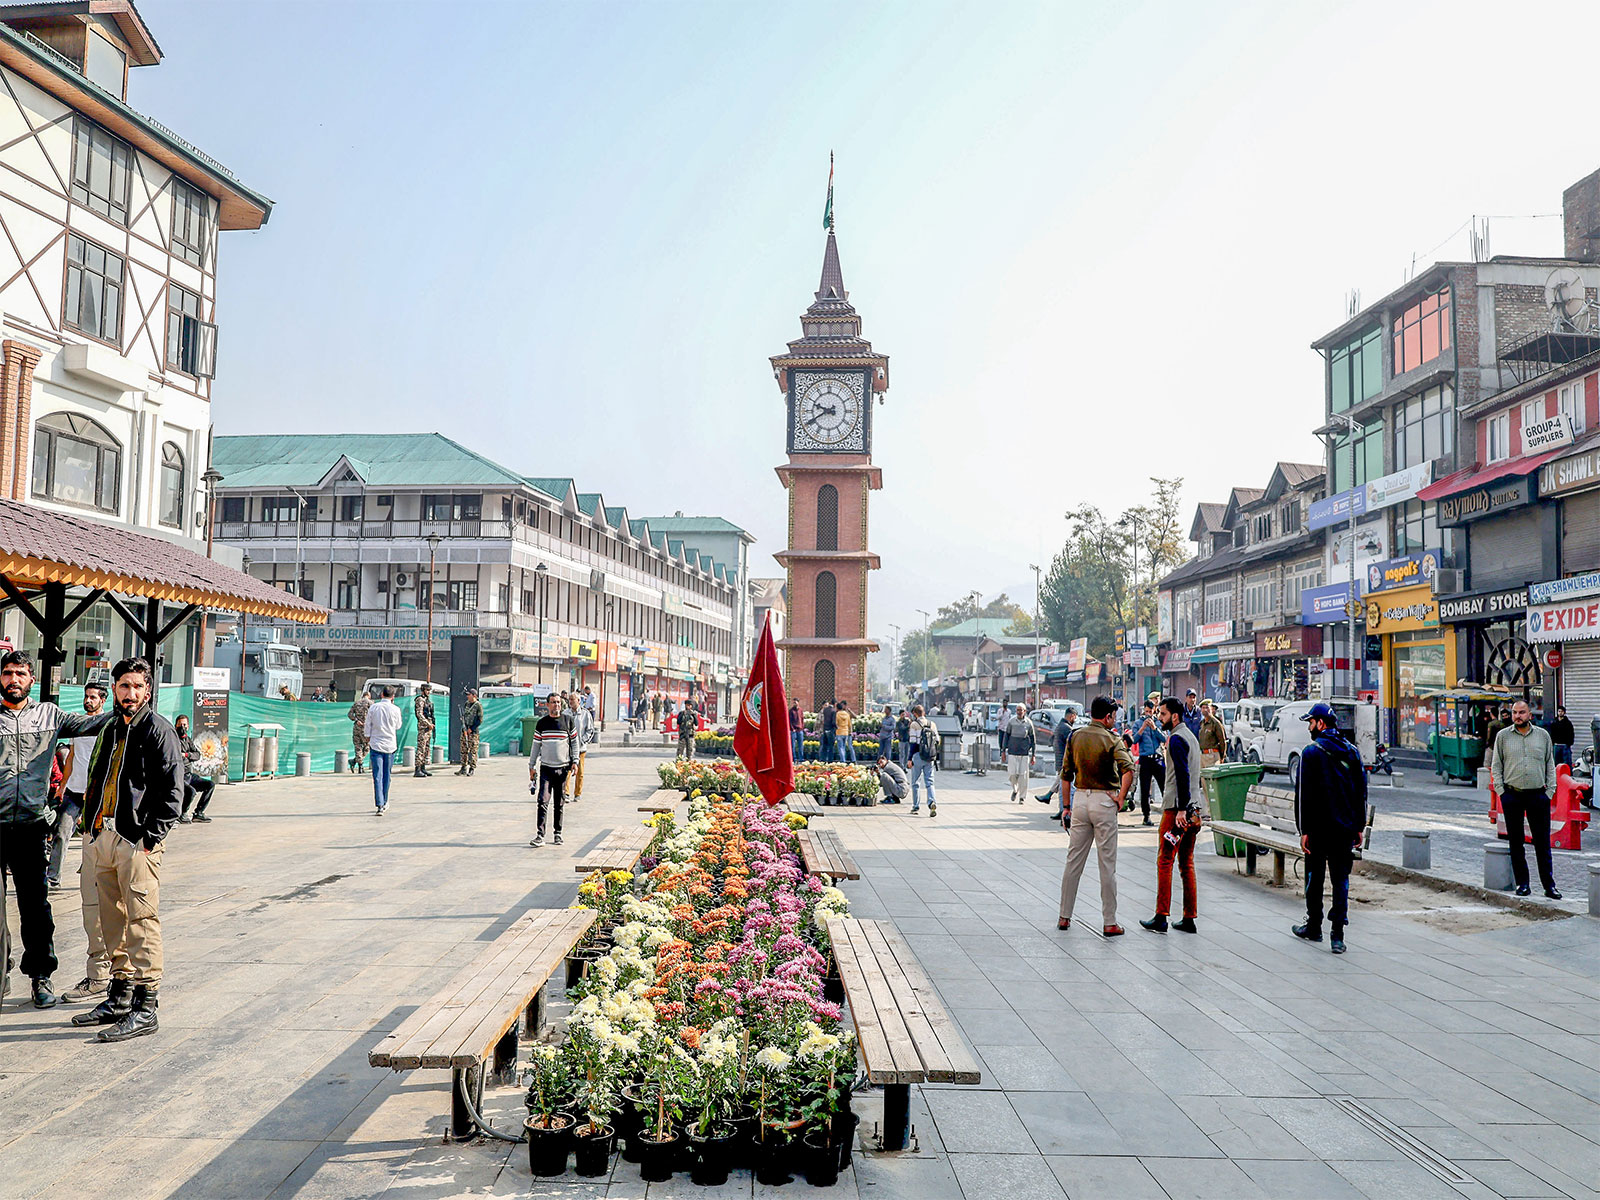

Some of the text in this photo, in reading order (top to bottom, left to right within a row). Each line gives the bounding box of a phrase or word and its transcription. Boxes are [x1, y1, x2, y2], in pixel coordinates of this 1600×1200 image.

[1525, 418, 1562, 438] GROUP-4
[1528, 430, 1564, 448] SUPPLIERS
[1540, 464, 1557, 493] JK
[1559, 455, 1594, 485] SHAWL
[1490, 489, 1518, 506] SUITING
[1541, 584, 1550, 596] JK
[1552, 578, 1579, 594] SHAWL
[1440, 591, 1529, 618] BOMBAY STORE
[1543, 603, 1600, 632] EXIDE
[328, 628, 391, 640] GOVERNMENT
[393, 629, 416, 640] ARTS
